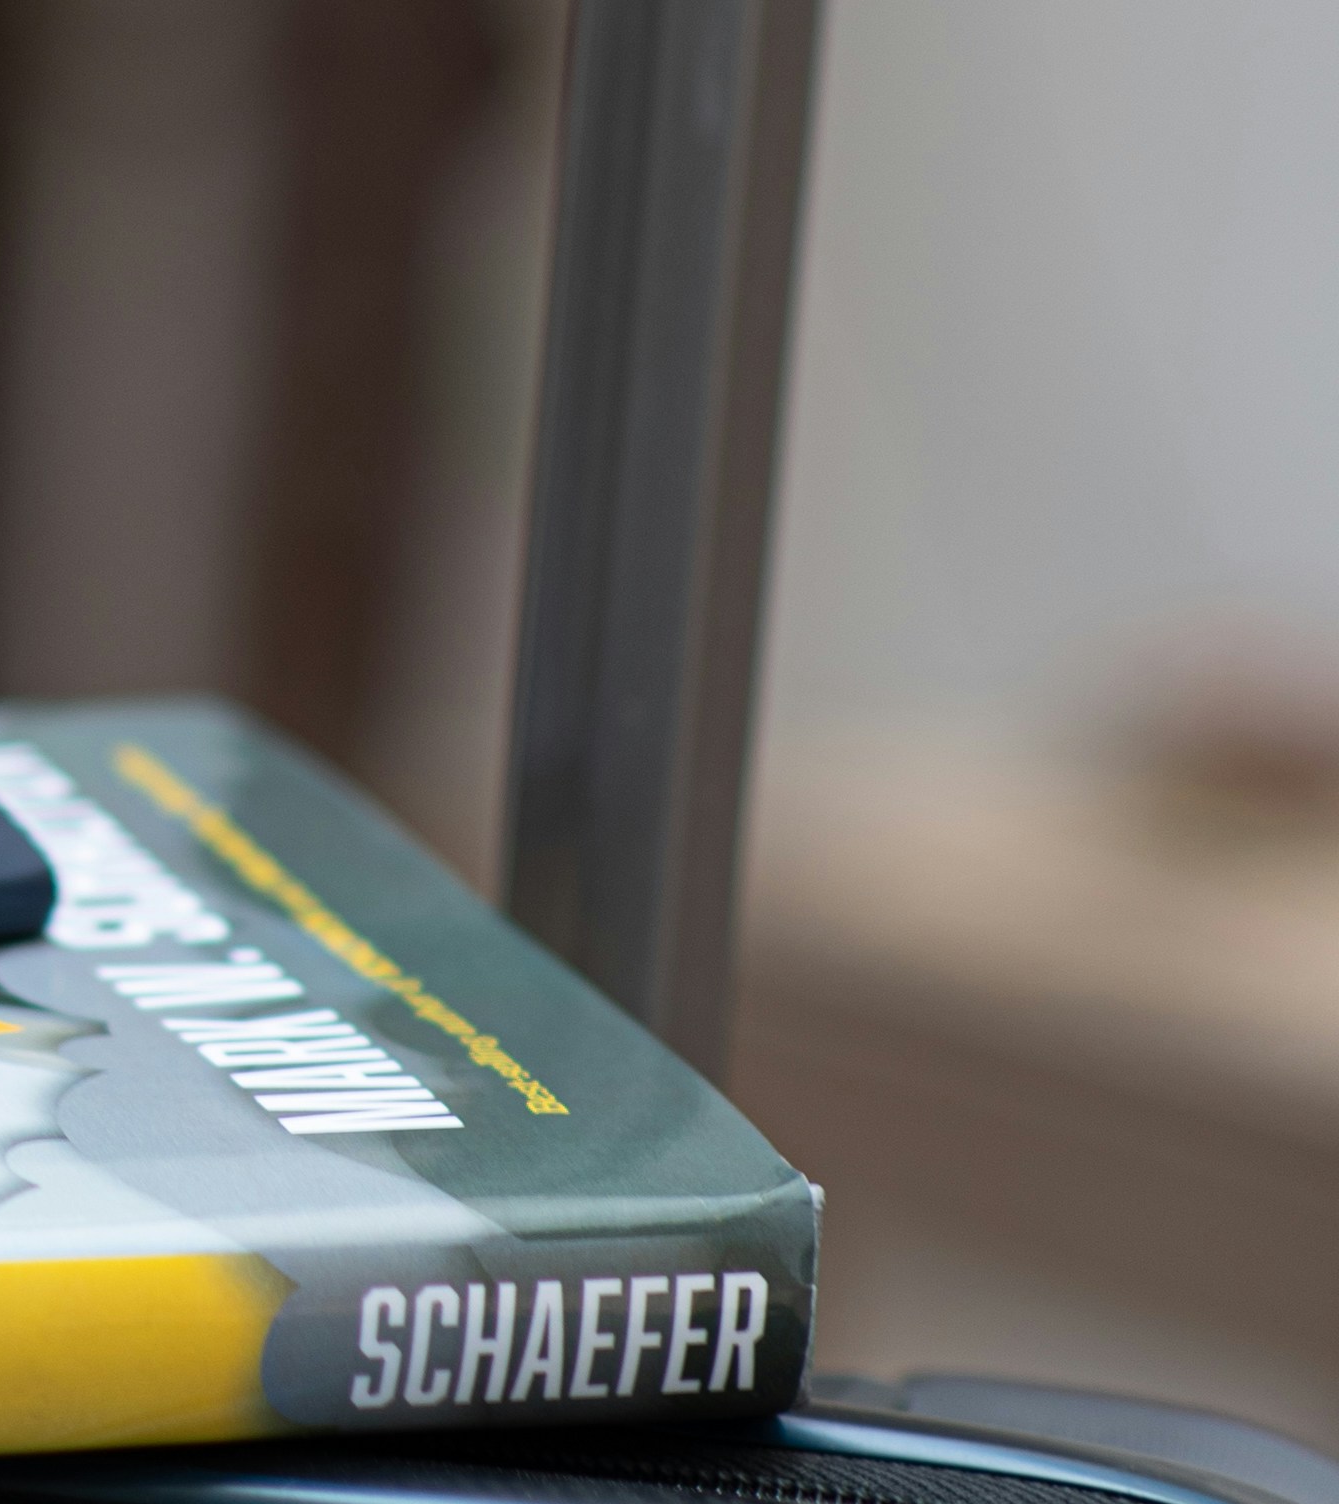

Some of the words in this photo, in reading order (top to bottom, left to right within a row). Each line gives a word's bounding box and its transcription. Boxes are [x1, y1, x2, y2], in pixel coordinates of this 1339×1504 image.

[96, 948, 305, 1009] W.
[163, 1009, 464, 1134] MARK
[350, 1271, 768, 1409] SCHAEFER
